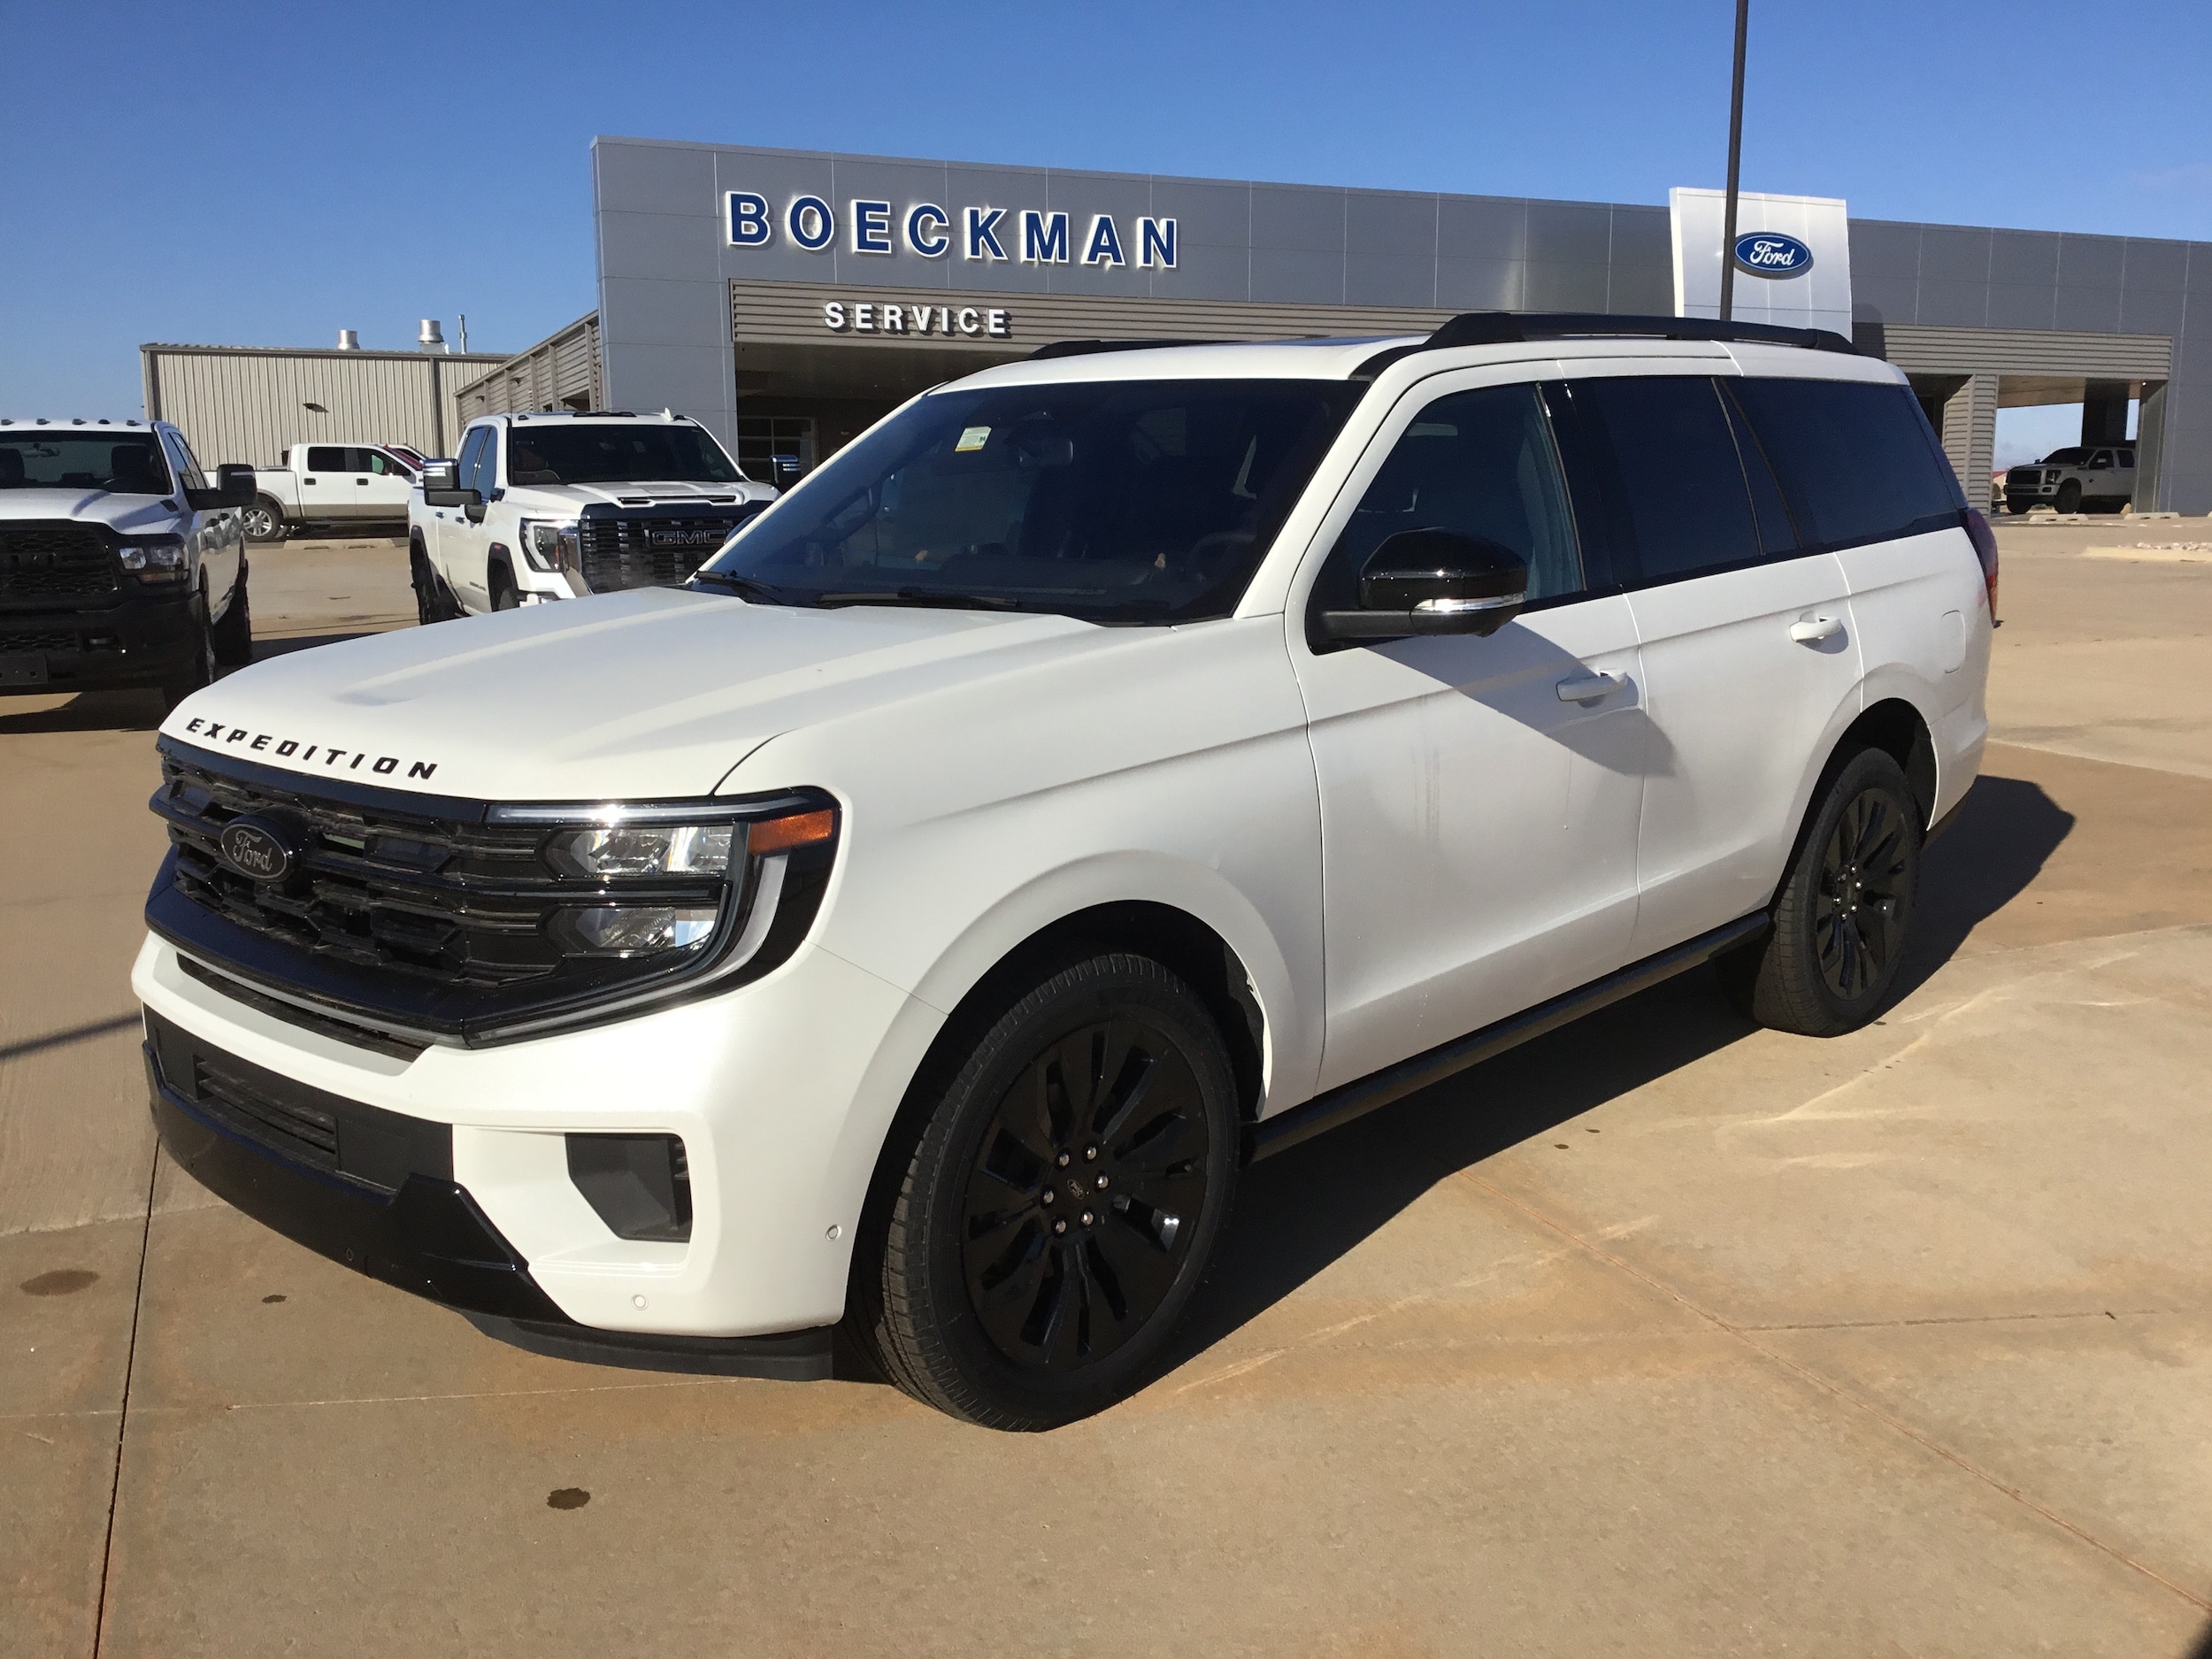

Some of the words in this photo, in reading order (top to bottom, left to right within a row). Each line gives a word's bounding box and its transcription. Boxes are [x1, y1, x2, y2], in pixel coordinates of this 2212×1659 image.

[725, 190, 1178, 268] BOECKMAN
[1749, 240, 1795, 265] Ford
[824, 301, 1008, 334] SERVICE
[652, 529, 726, 545] GMC
[186, 718, 438, 780] EXPEDITION
[233, 829, 273, 872] Ford
